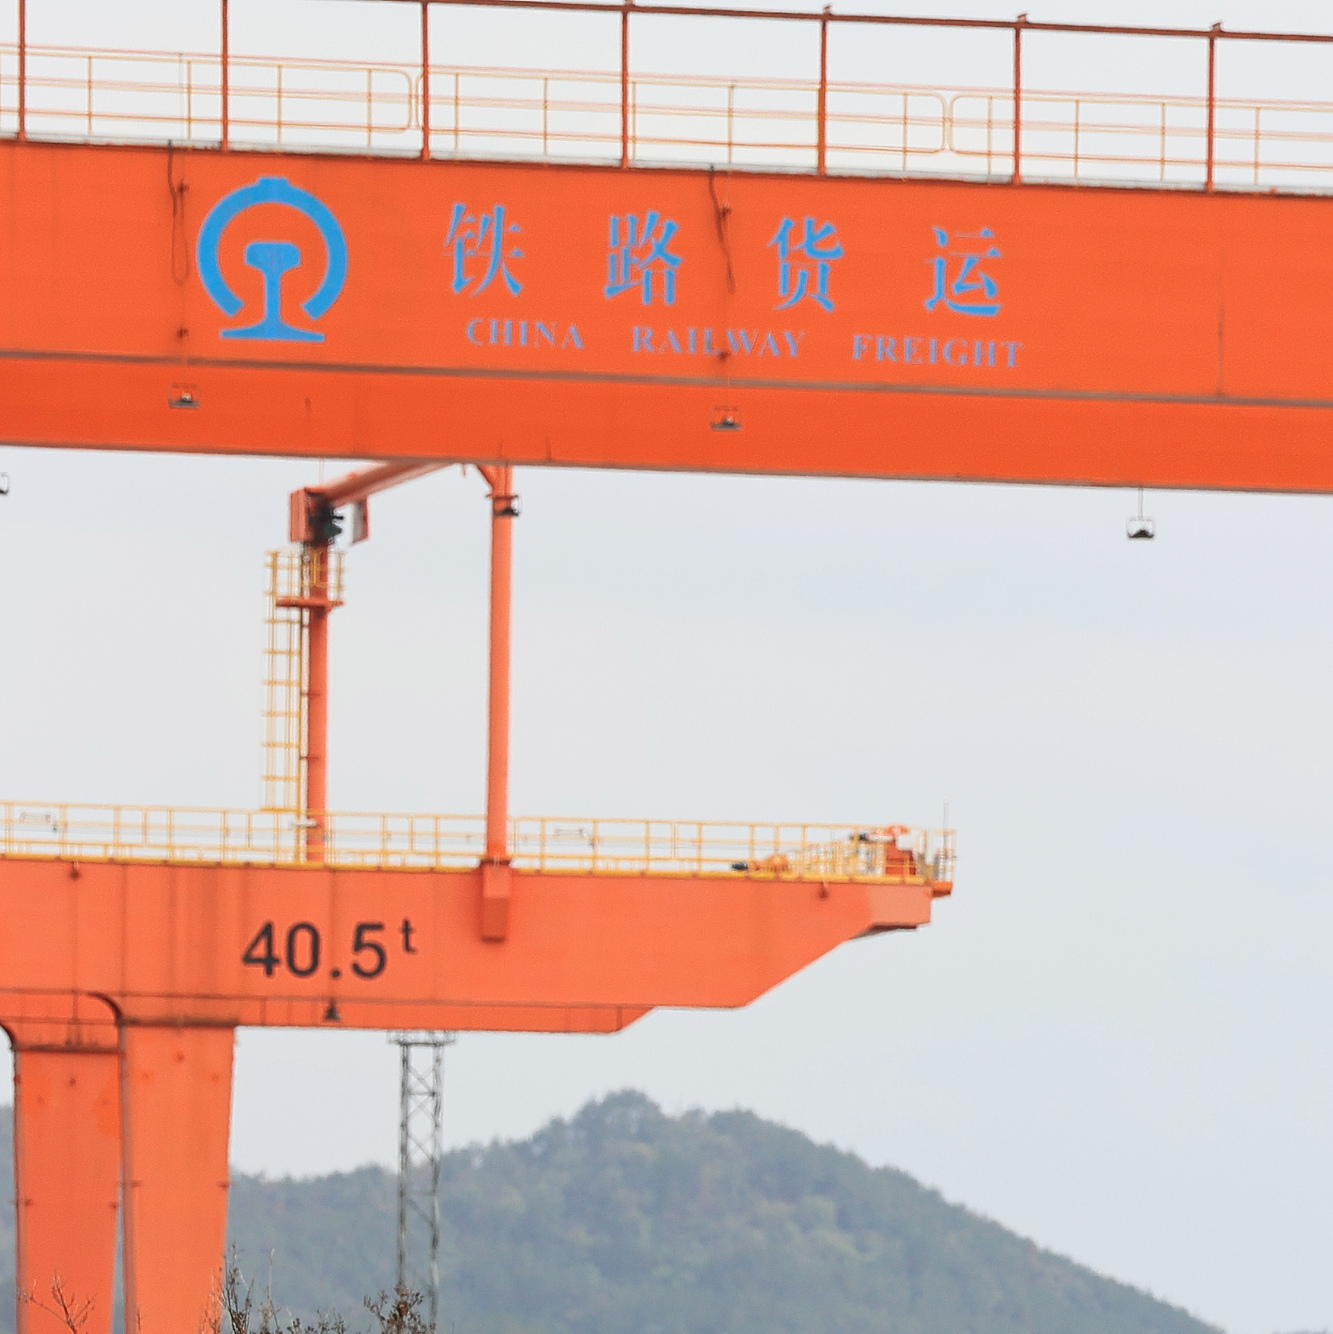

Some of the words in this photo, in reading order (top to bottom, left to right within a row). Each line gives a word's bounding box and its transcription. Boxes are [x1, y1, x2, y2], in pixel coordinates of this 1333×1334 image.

[443, 202, 1003, 317] 铁路货运
[466, 317, 584, 350] CHINA
[632, 325, 806, 360] RAILWAY
[852, 332, 1024, 368] FREIGHT
